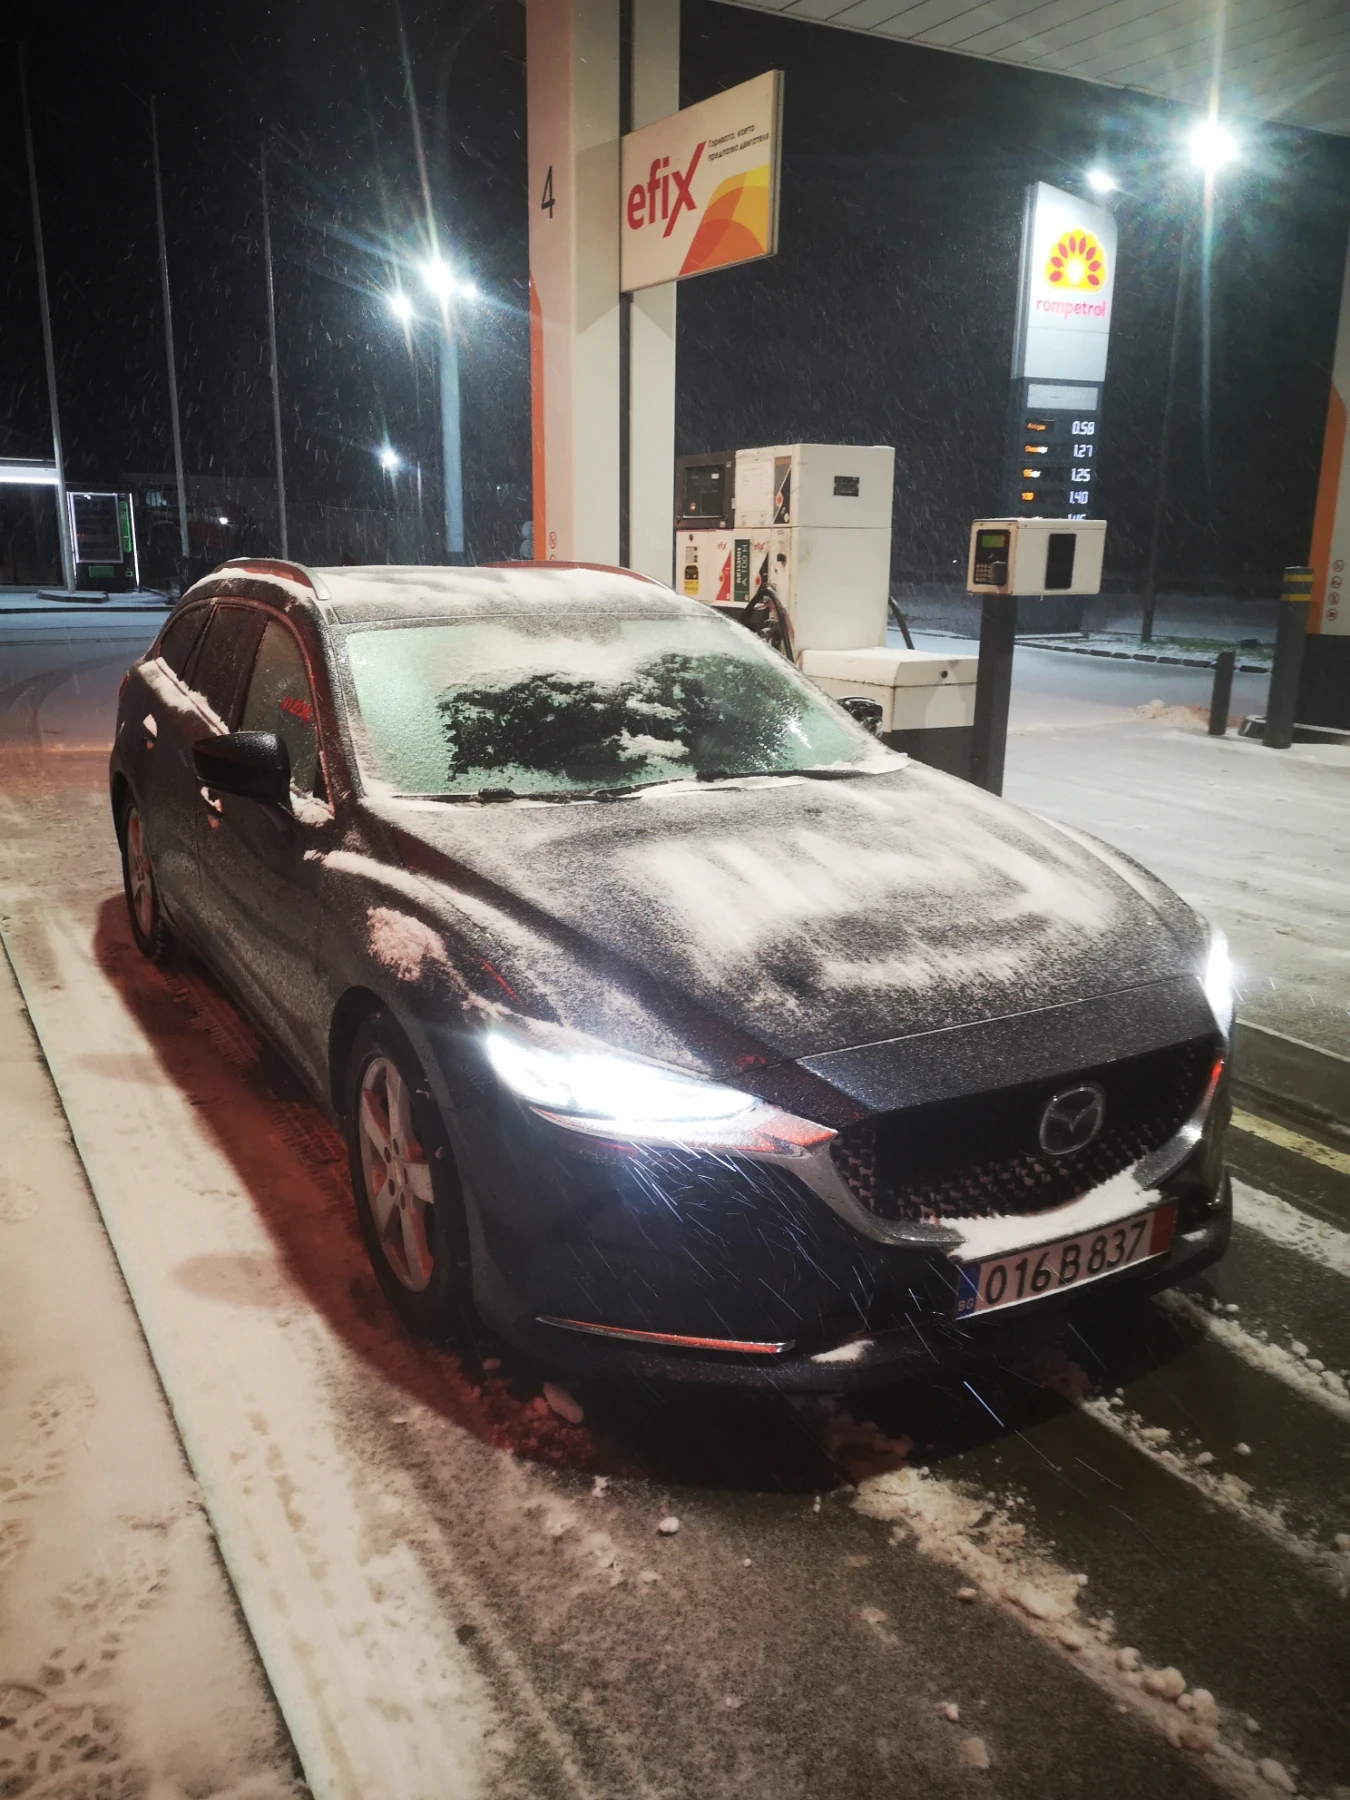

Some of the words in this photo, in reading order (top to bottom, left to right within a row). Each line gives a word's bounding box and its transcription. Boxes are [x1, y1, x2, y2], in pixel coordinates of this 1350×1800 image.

[541, 165, 555, 219] 4
[627, 141, 707, 238] efix
[1037, 300, 1106, 319] rompetrol
[957, 1300, 974, 1311] BG
